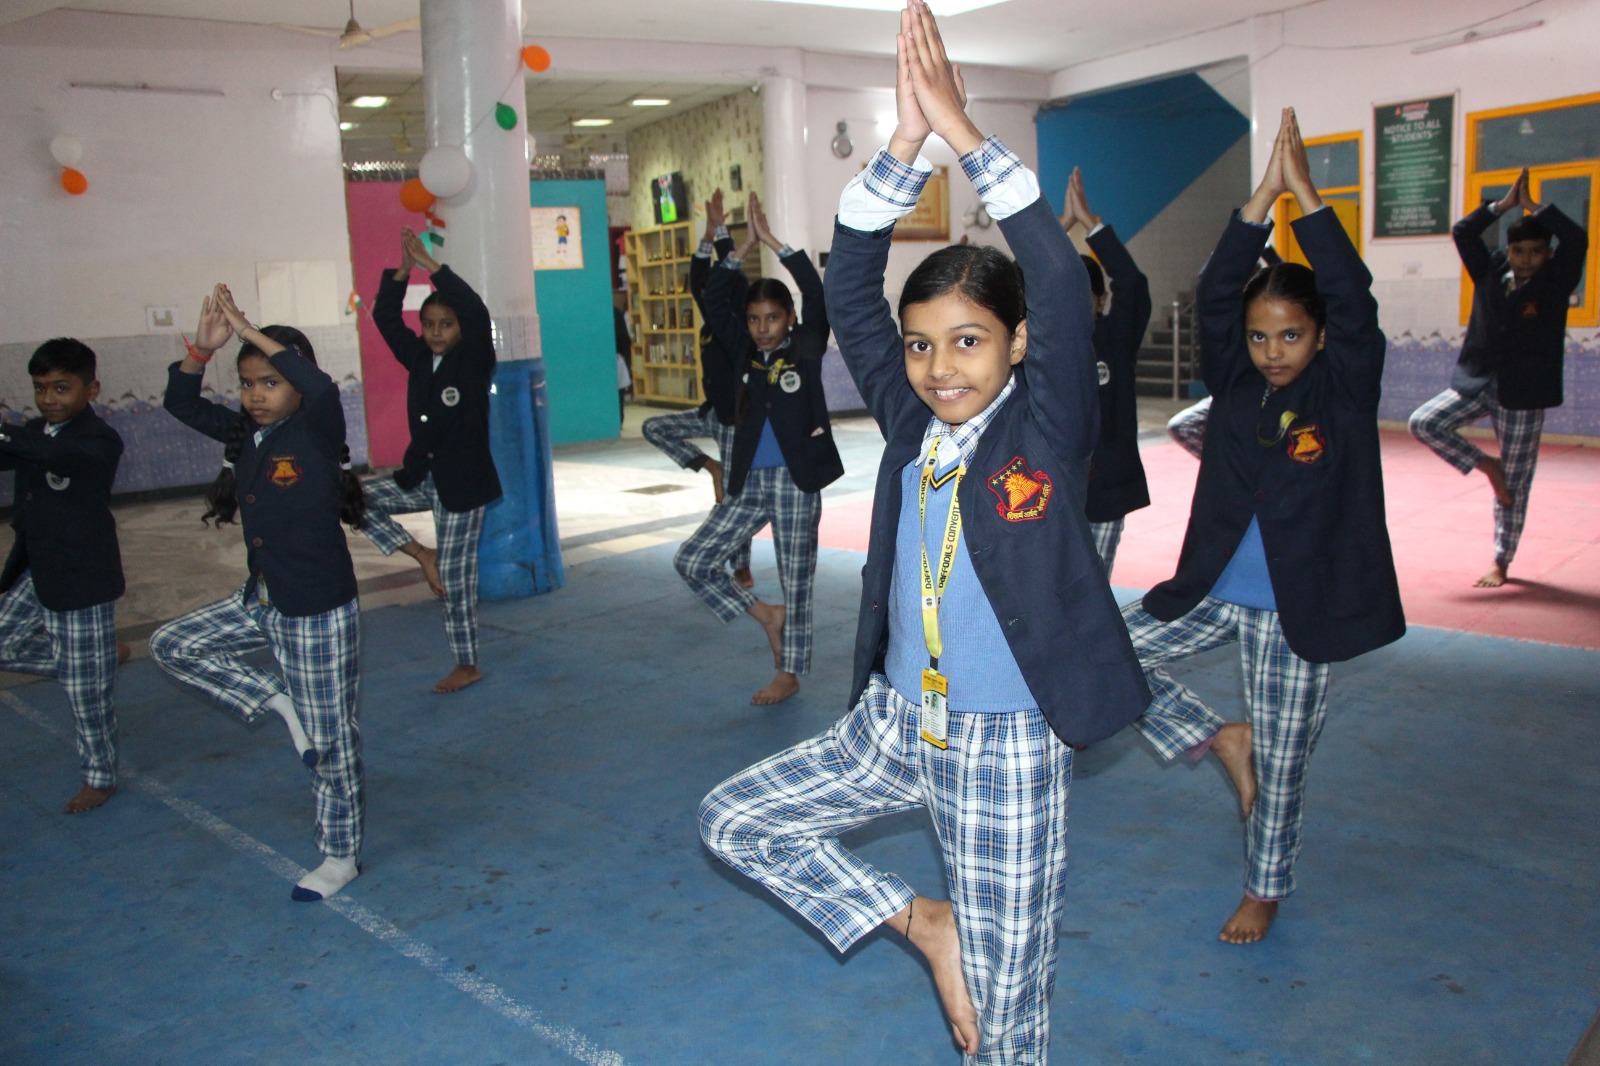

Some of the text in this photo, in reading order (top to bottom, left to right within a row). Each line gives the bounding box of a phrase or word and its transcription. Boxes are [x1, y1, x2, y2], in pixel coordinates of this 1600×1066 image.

[1383, 118, 1441, 135] NOTICE TO ALL
[1391, 130, 1433, 143] STUDENTS
[938, 544, 953, 588] DAFFODILS
[948, 505, 960, 542] CONVENT
